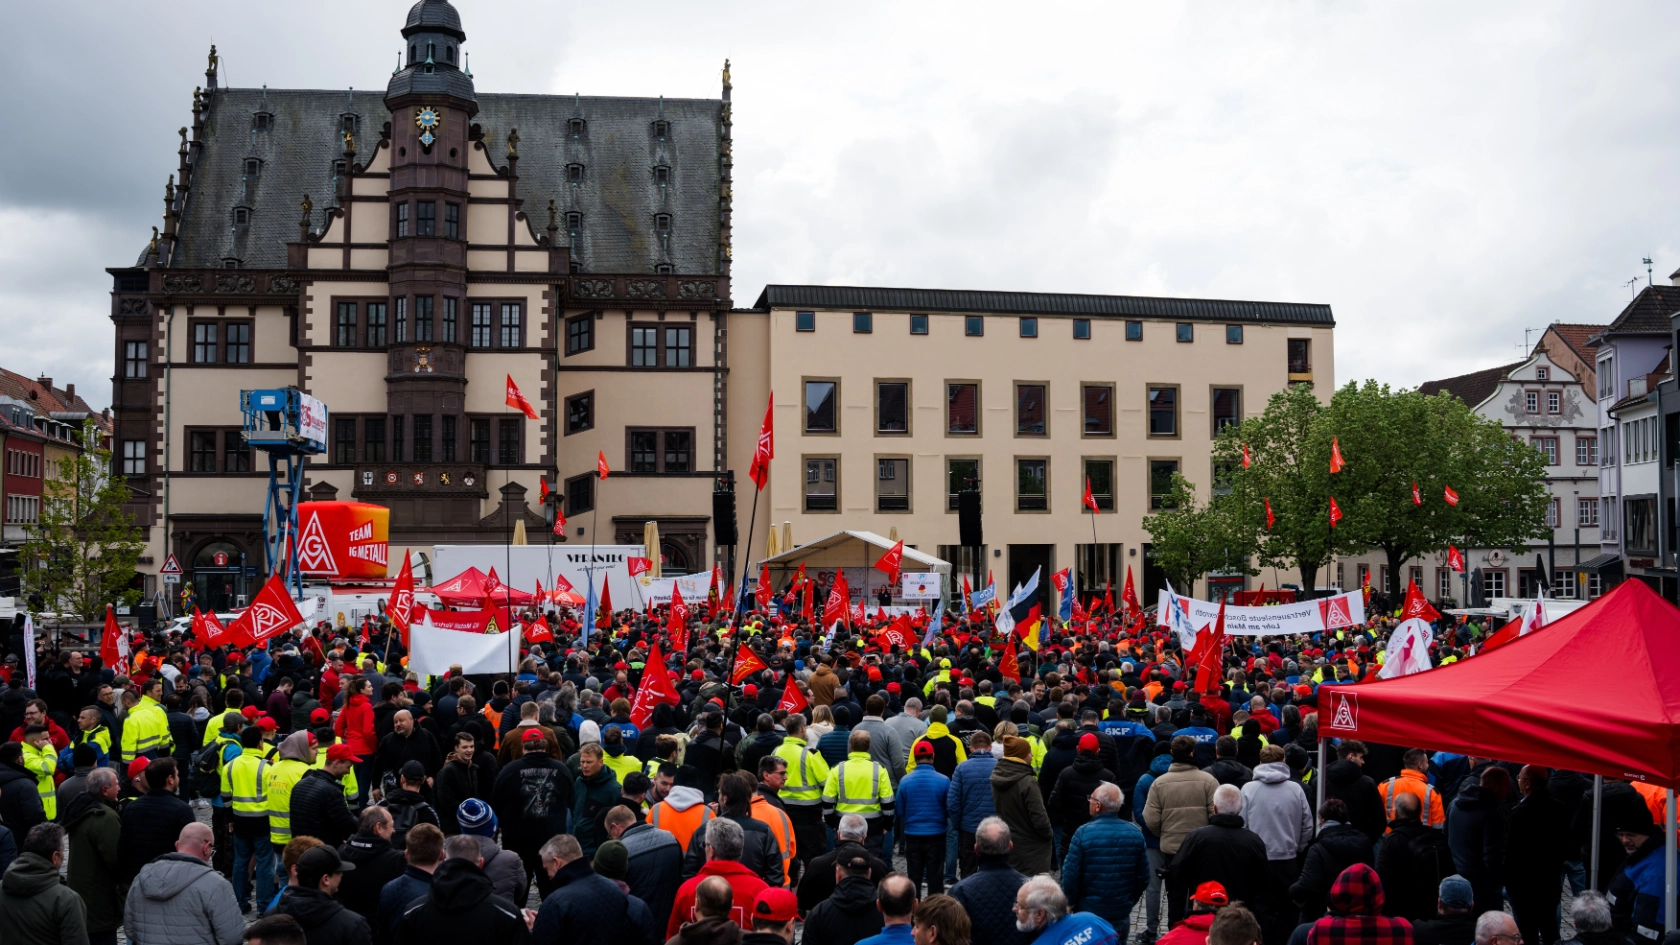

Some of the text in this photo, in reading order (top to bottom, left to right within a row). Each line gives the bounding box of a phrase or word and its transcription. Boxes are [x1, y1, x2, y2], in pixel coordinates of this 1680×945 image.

[349, 522, 372, 541] TEAM
[349, 543, 387, 565] IG METALL
